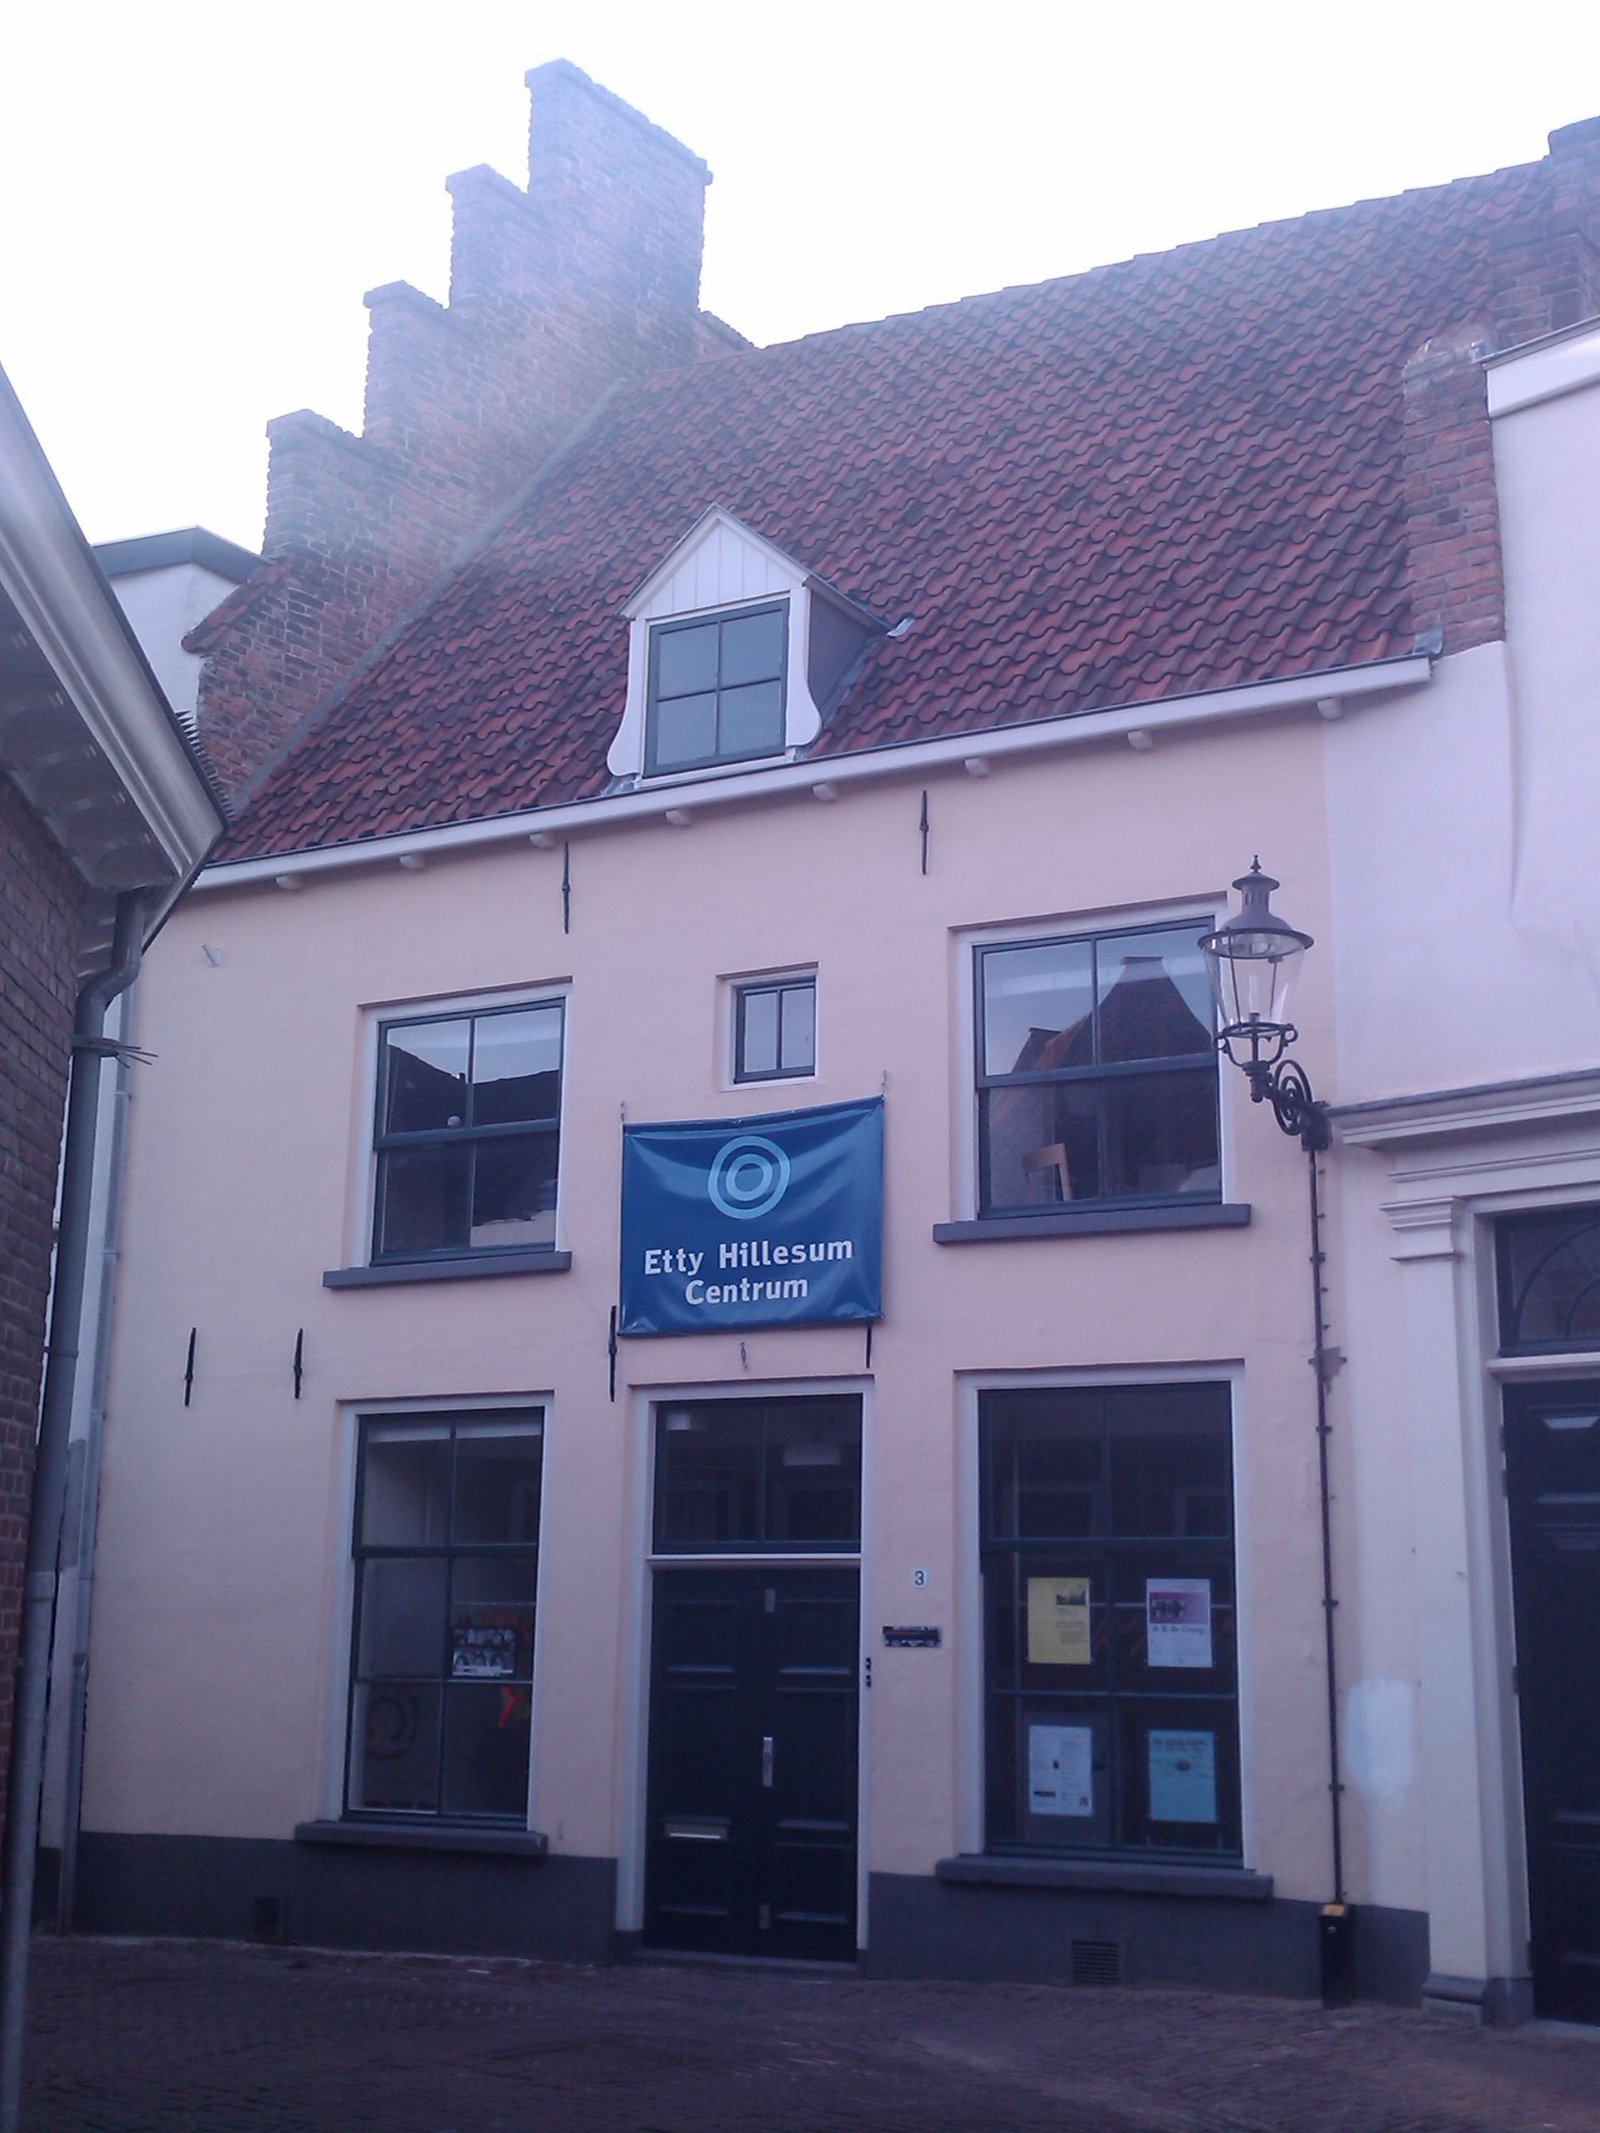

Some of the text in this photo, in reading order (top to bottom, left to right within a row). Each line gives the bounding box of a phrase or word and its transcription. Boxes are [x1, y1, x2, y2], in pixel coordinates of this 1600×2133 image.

[644, 1239, 854, 1276] Etty Hillesum
[684, 1278, 809, 1306] Centrum
[914, 1570, 925, 1586] 3
